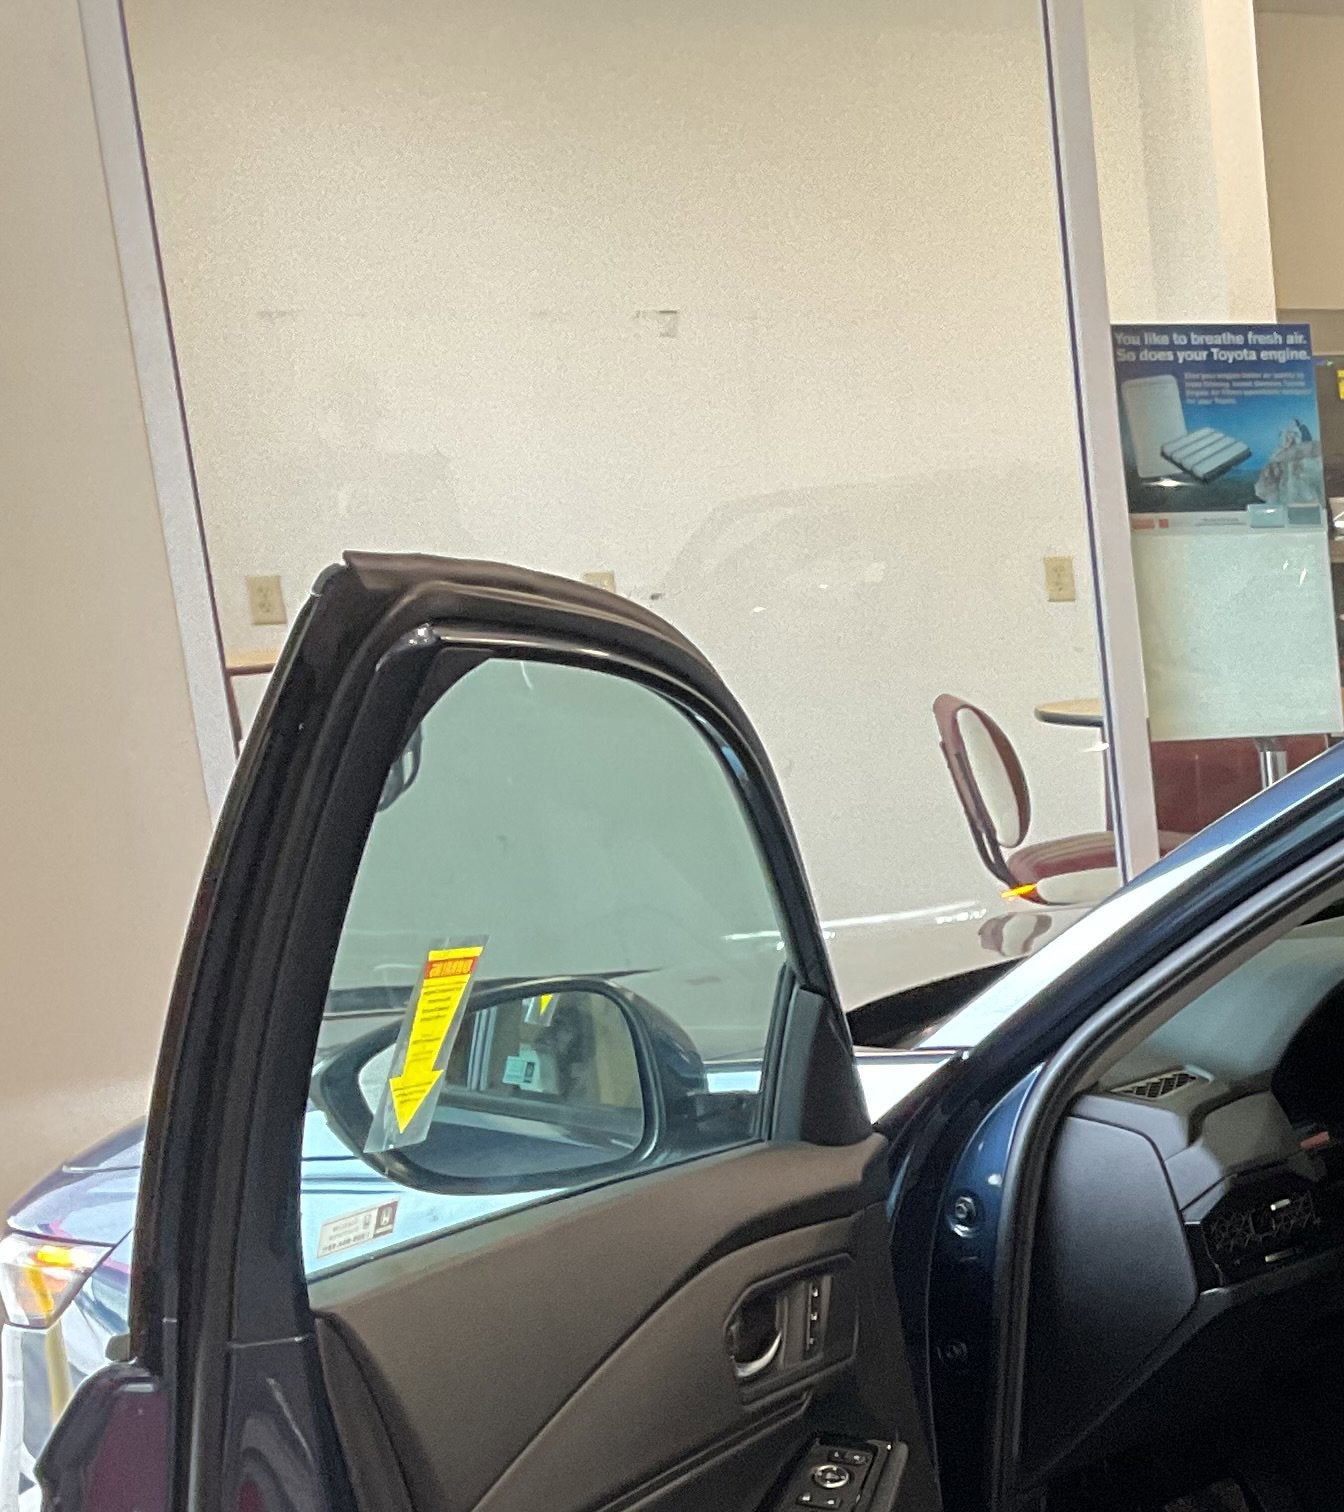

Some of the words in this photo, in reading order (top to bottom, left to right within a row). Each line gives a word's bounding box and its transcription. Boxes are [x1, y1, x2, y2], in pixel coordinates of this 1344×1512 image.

[1115, 332, 1140, 346] You
[1144, 331, 1170, 345] like
[1173, 332, 1187, 345] to
[1190, 331, 1244, 345] breathe
[1248, 331, 1282, 345] fresh
[1286, 331, 1307, 345] air.
[1116, 349, 1136, 362] So
[1139, 348, 1174, 361] does
[1177, 350, 1208, 364] your
[1210, 348, 1258, 364] Toyota
[1260, 348, 1311, 363] engine.
